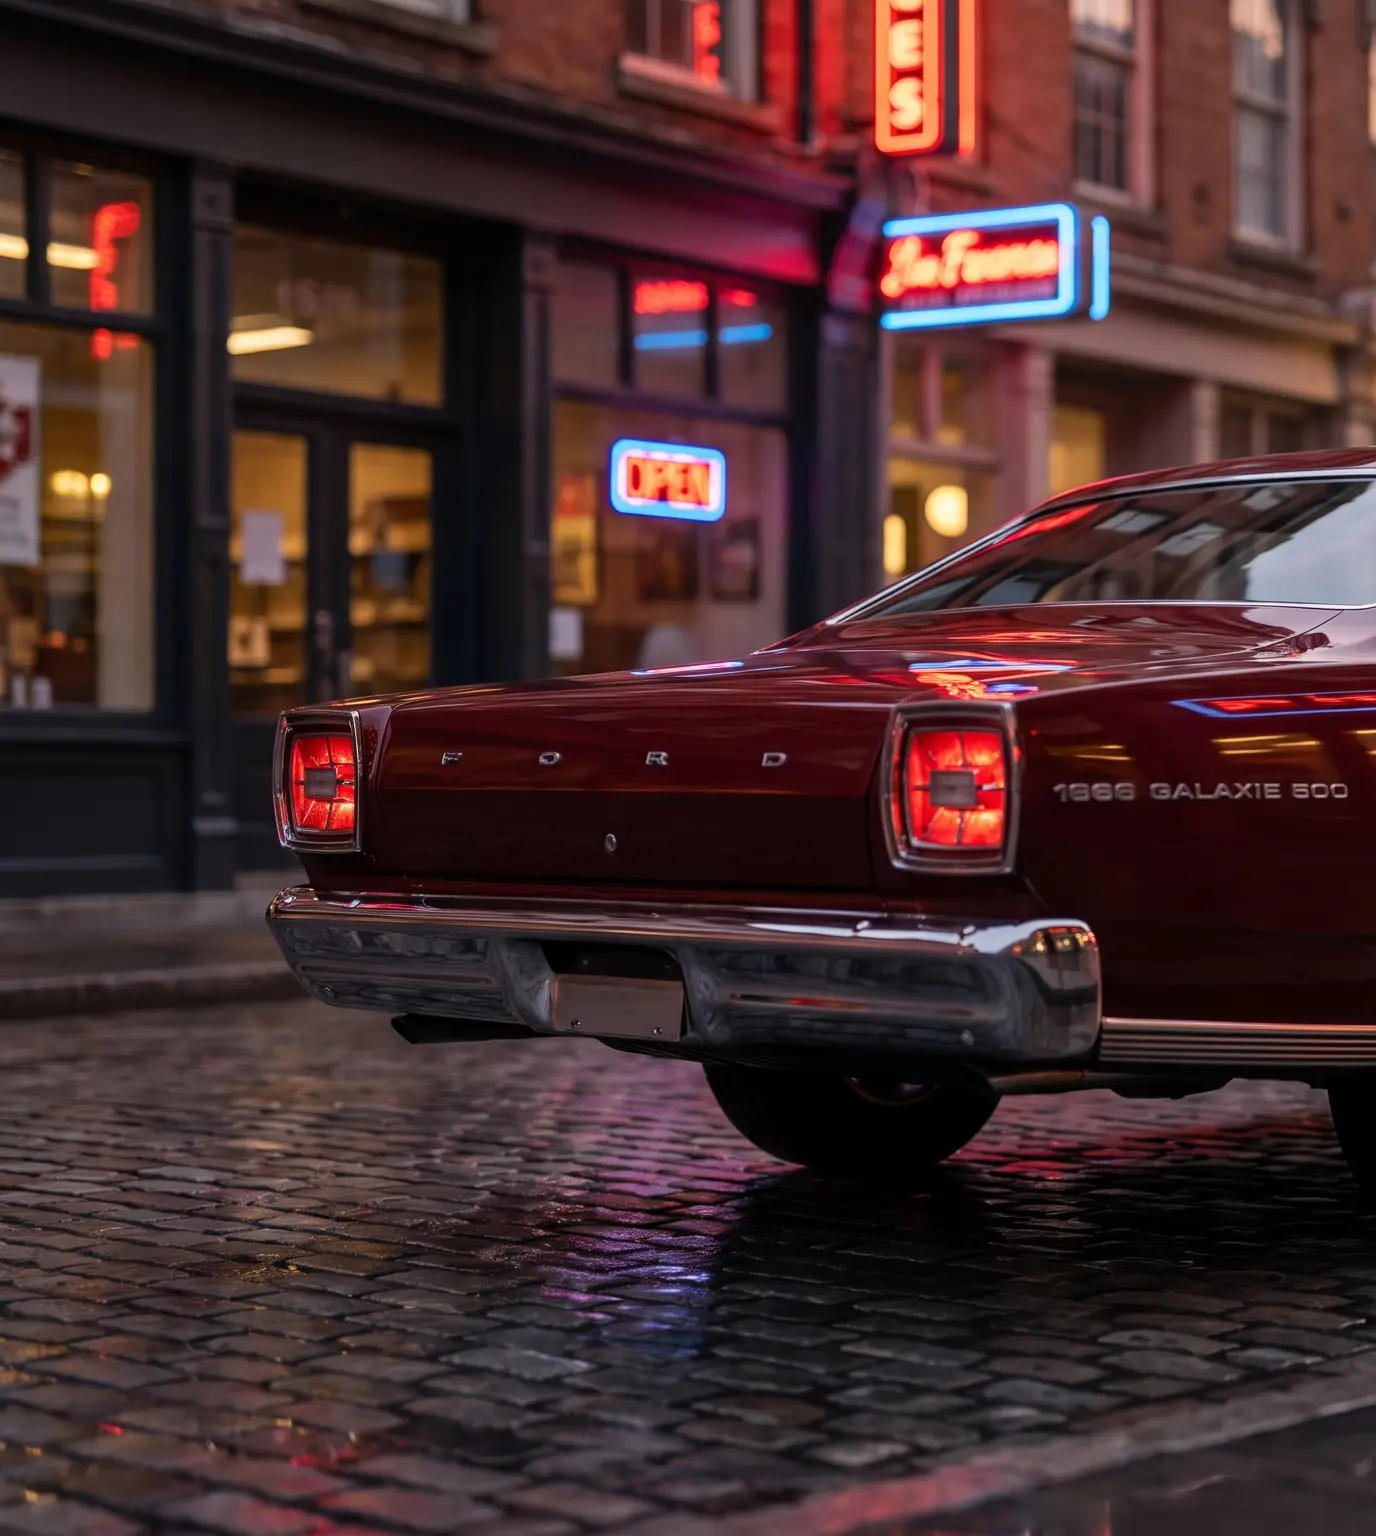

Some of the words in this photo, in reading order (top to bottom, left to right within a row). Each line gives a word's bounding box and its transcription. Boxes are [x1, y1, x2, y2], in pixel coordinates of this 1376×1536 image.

[888, 0, 924, 130] ES
[624, 453, 713, 508] OPEN
[441, 751, 788, 767] FORD
[1149, 783, 1282, 799] GALAXIE
[1292, 783, 1348, 799] 500
